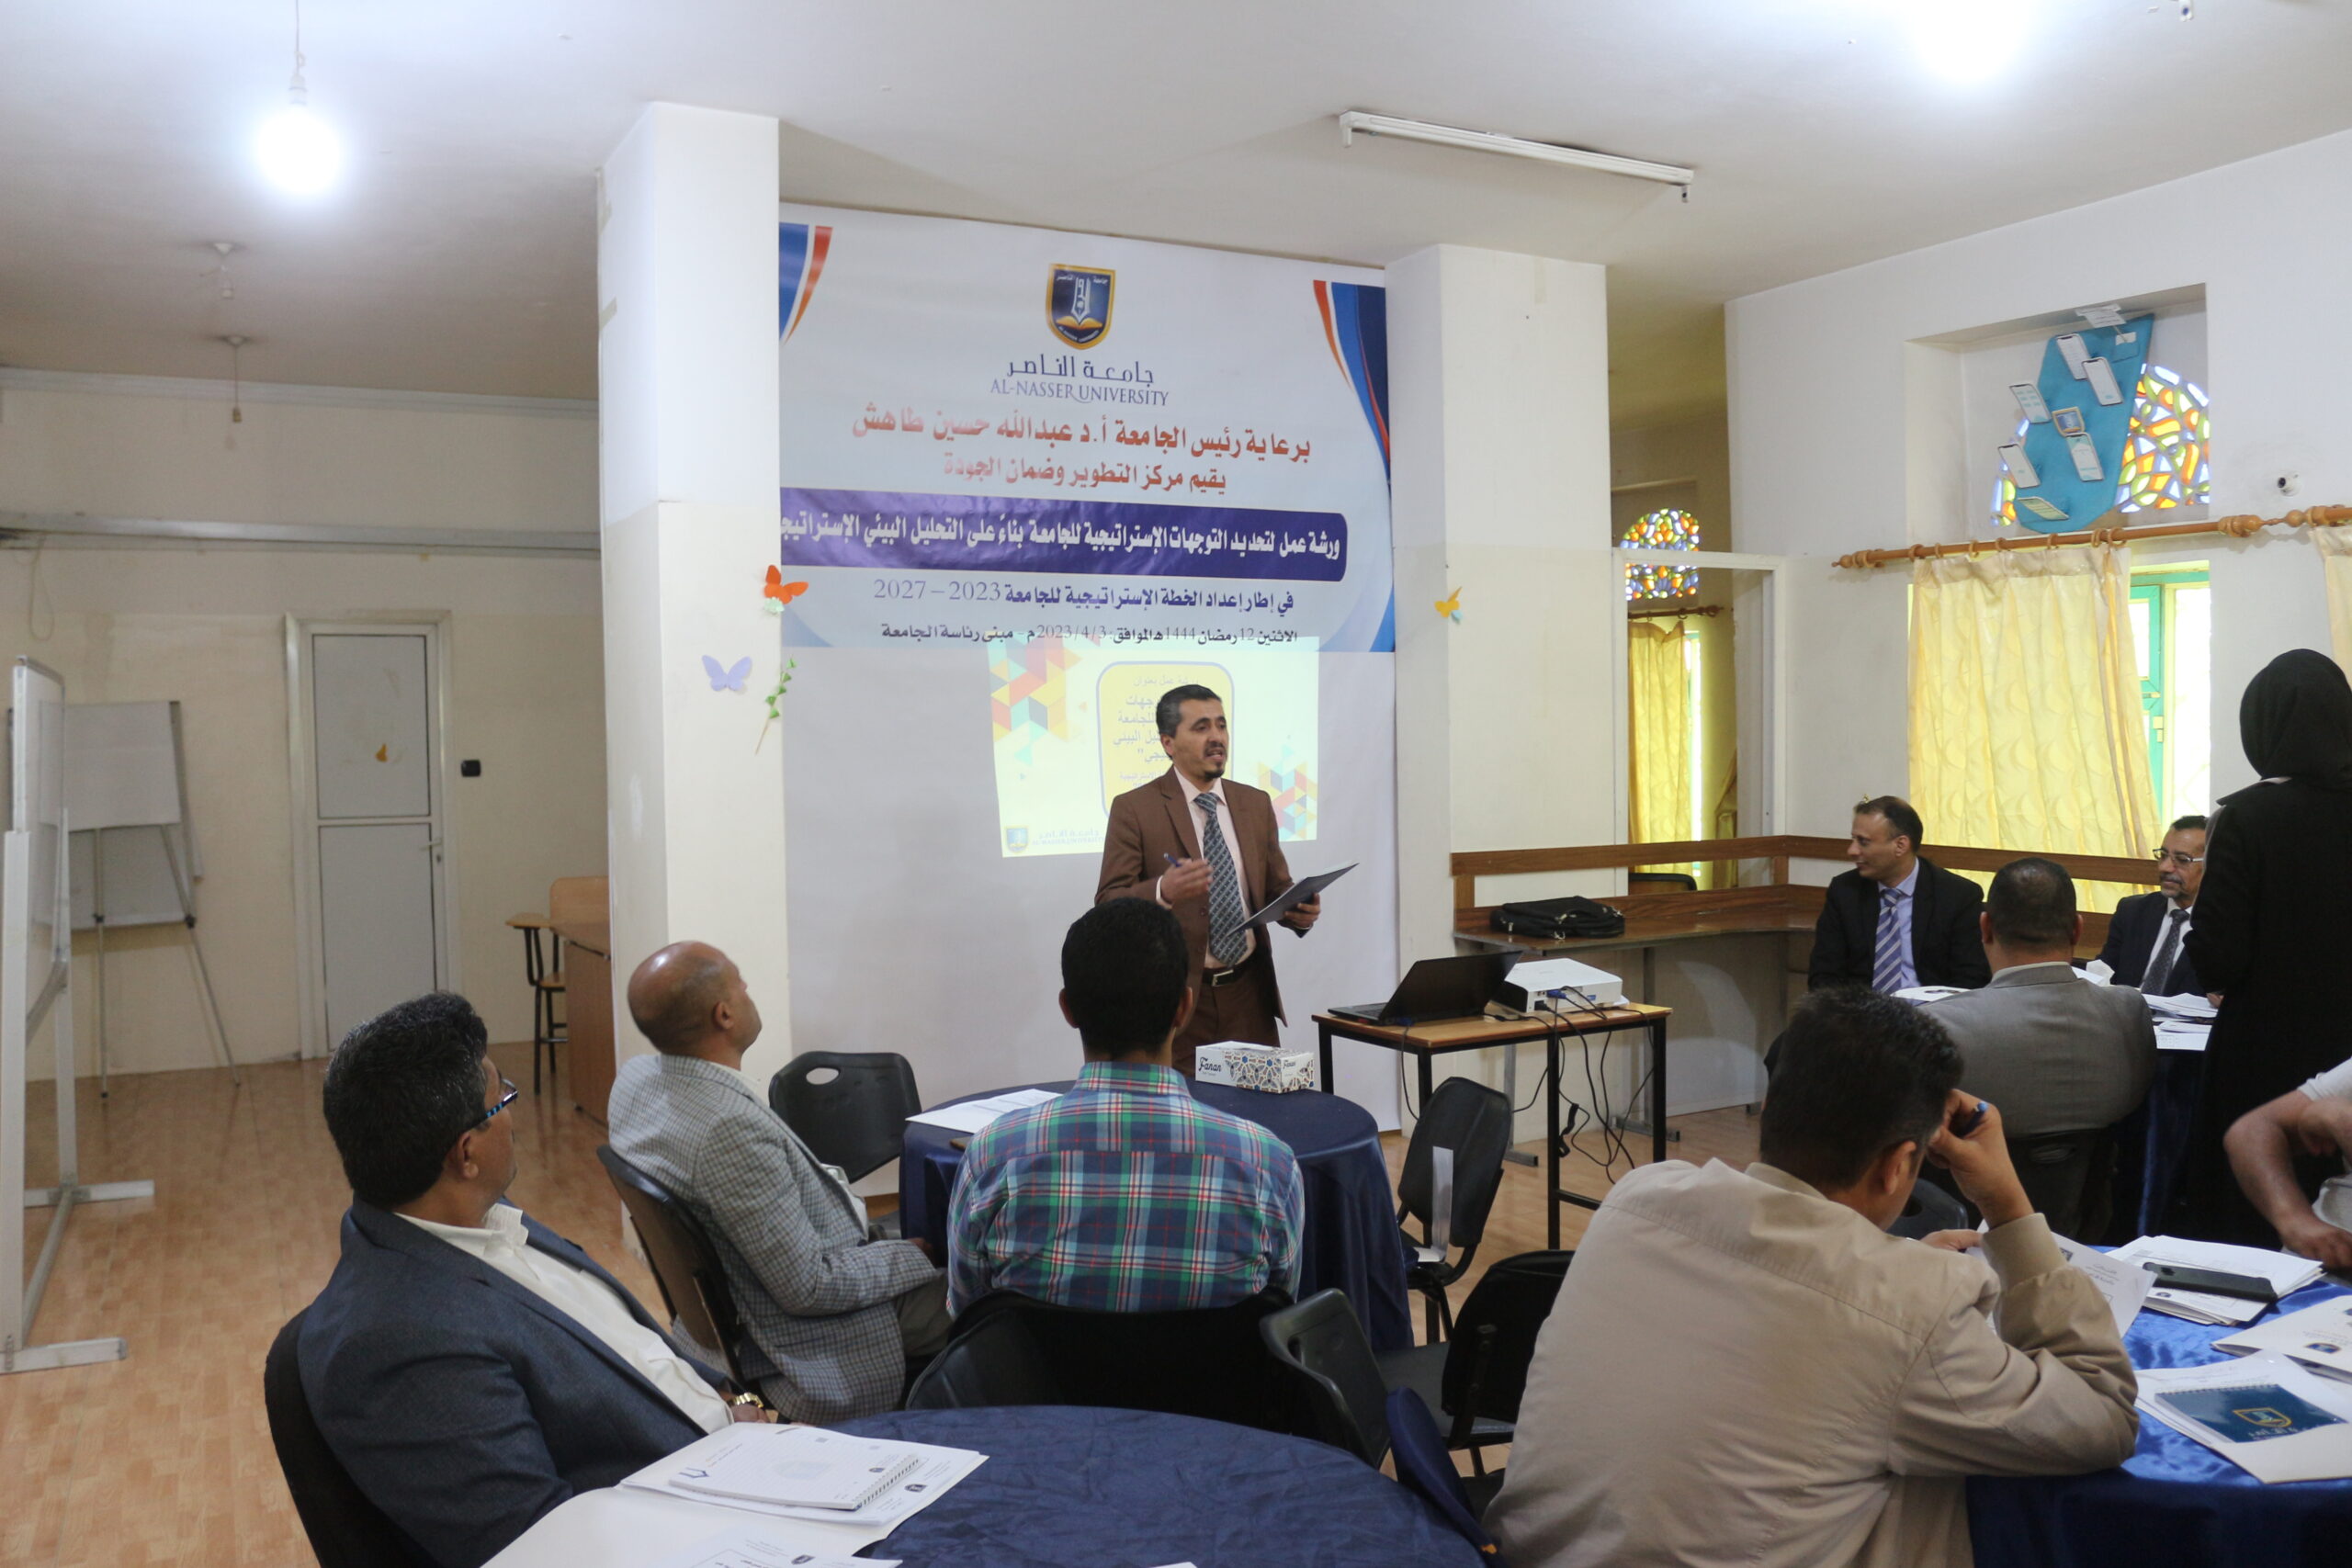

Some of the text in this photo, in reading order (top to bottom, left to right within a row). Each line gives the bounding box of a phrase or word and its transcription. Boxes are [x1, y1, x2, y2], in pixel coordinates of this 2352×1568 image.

[1007, 354, 1154, 388] جامعة الناصر
[990, 378, 1169, 406] AL-NASSER UNIVERSITY
[933, 410, 990, 441] حسين
[1114, 419, 1186, 455] الجامعة
[1191, 426, 1241, 457] رئيس
[1245, 429, 1311, 463] برعاية
[944, 452, 1227, 495] يقيم مركز التطوير وضمان الجودة
[863, 513, 907, 547] البيئي
[910, 515, 964, 545] التحليل
[967, 518, 996, 548] على
[1029, 519, 1082, 550] للجامعة
[1169, 525, 1227, 555] التوجهات
[1230, 530, 1276, 558] لتحديد
[1279, 531, 1306, 558] عمل
[1308, 530, 1340, 560] ورشة
[1004, 584, 1061, 608] للجامعة
[1161, 587, 1203, 607] الخطة
[1206, 592, 1242, 613] إعداد
[1245, 591, 1274, 614] إطار
[1277, 591, 1295, 617] في
[881, 623, 938, 642] الجامعة
[981, 626, 1013, 643] مبنى
[1198, 628, 1238, 645] رمضان
[1198, 1056, 1222, 1073] Fanan
